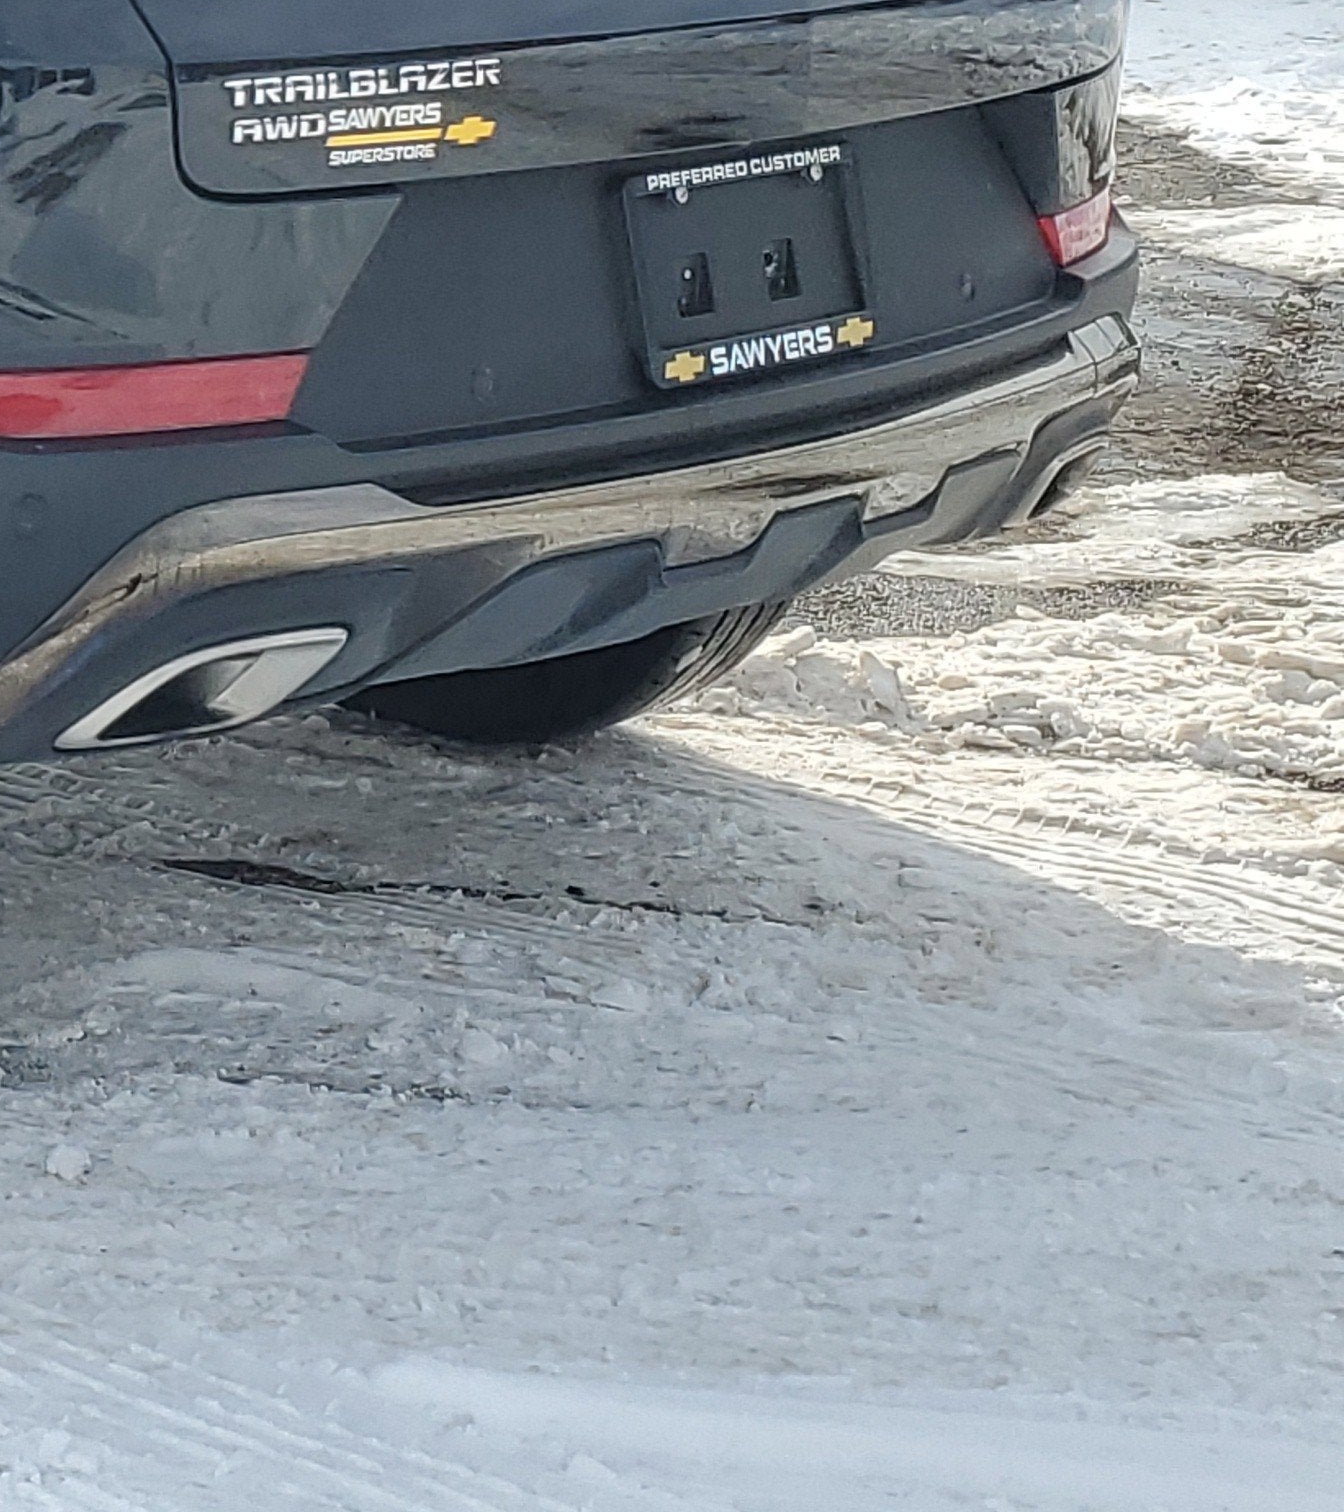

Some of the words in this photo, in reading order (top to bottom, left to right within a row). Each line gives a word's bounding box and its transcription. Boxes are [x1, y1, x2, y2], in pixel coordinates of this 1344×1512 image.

[224, 59, 501, 107] TRAILBLAZER
[232, 113, 327, 144] AWD
[328, 102, 442, 131] SAWYERS
[328, 143, 437, 166] SUPERSTORE
[646, 161, 748, 191] PREFERRED
[749, 145, 841, 174] CUSTOMER
[710, 325, 833, 376] SAWYERS
